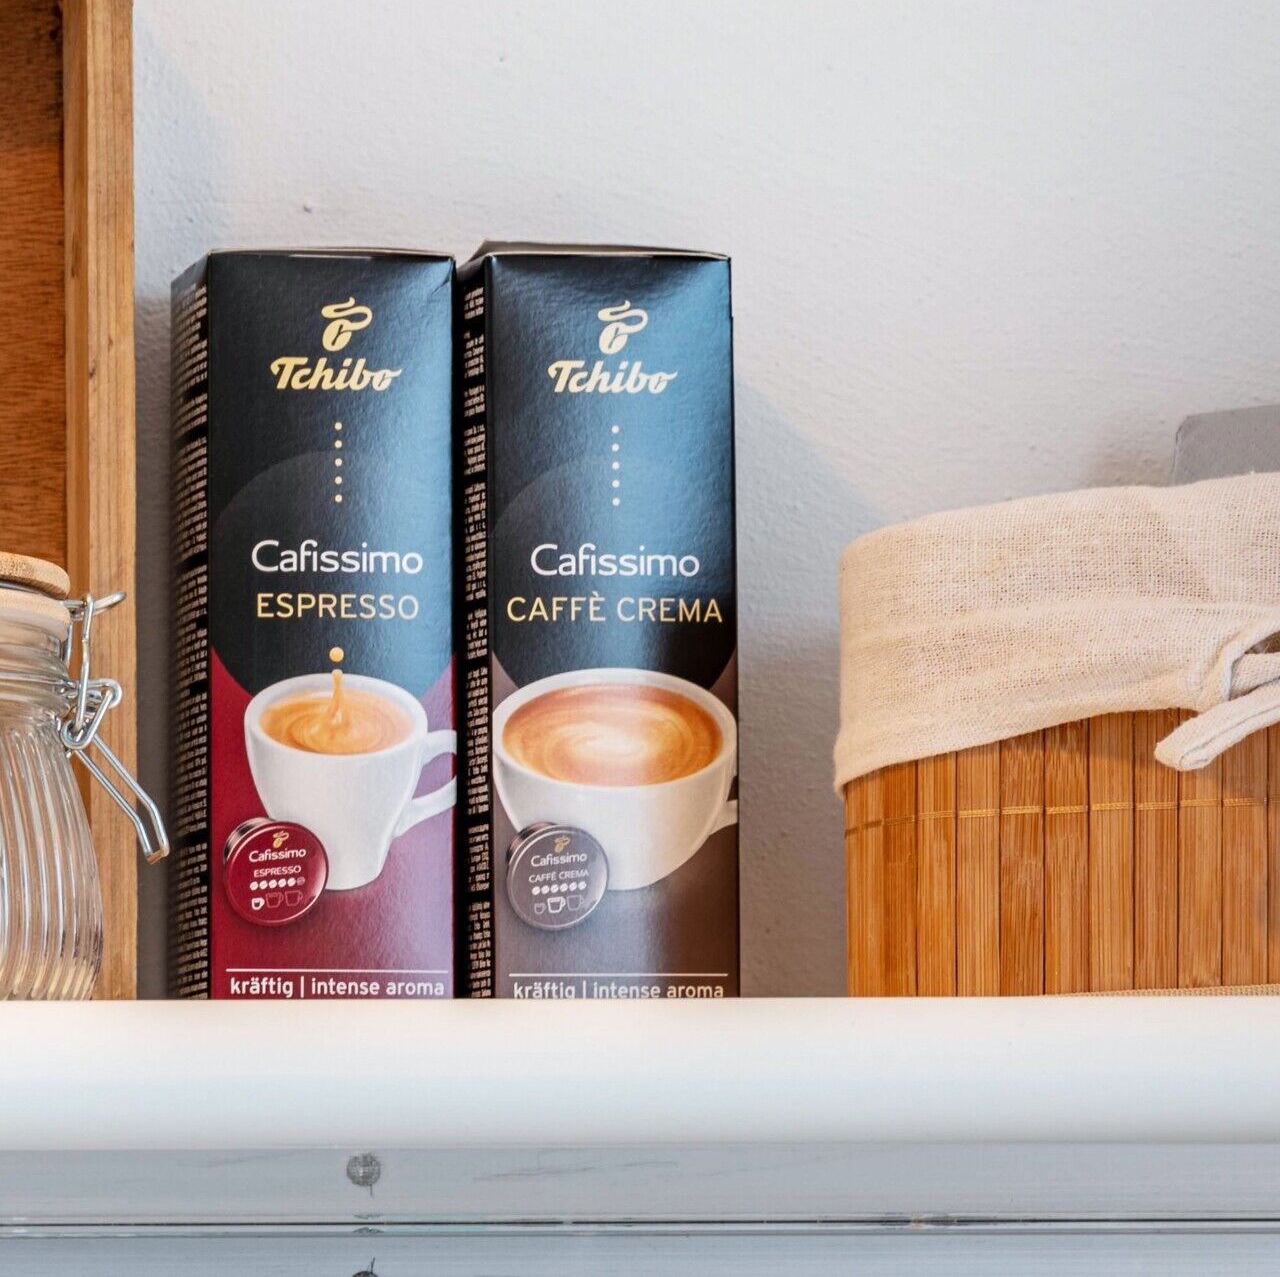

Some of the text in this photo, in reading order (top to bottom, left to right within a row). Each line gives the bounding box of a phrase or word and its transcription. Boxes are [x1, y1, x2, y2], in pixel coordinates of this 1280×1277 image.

[270, 356, 402, 391] Tchibo
[547, 360, 678, 395] Tchibo
[251, 539, 424, 576] Cafissimo
[530, 543, 700, 578] Cafissimo
[256, 592, 419, 620] ESPRESSO
[506, 590, 723, 623] CAFFÈ CREMA
[248, 848, 307, 863] Cafissimo
[530, 852, 588, 868] Cafissimo
[253, 865, 302, 878] ESPRESSO
[558, 868, 590, 880] CREMA
[230, 977, 445, 998] kräftig intense aroma
[513, 981, 725, 999] kräftig intense aroma
